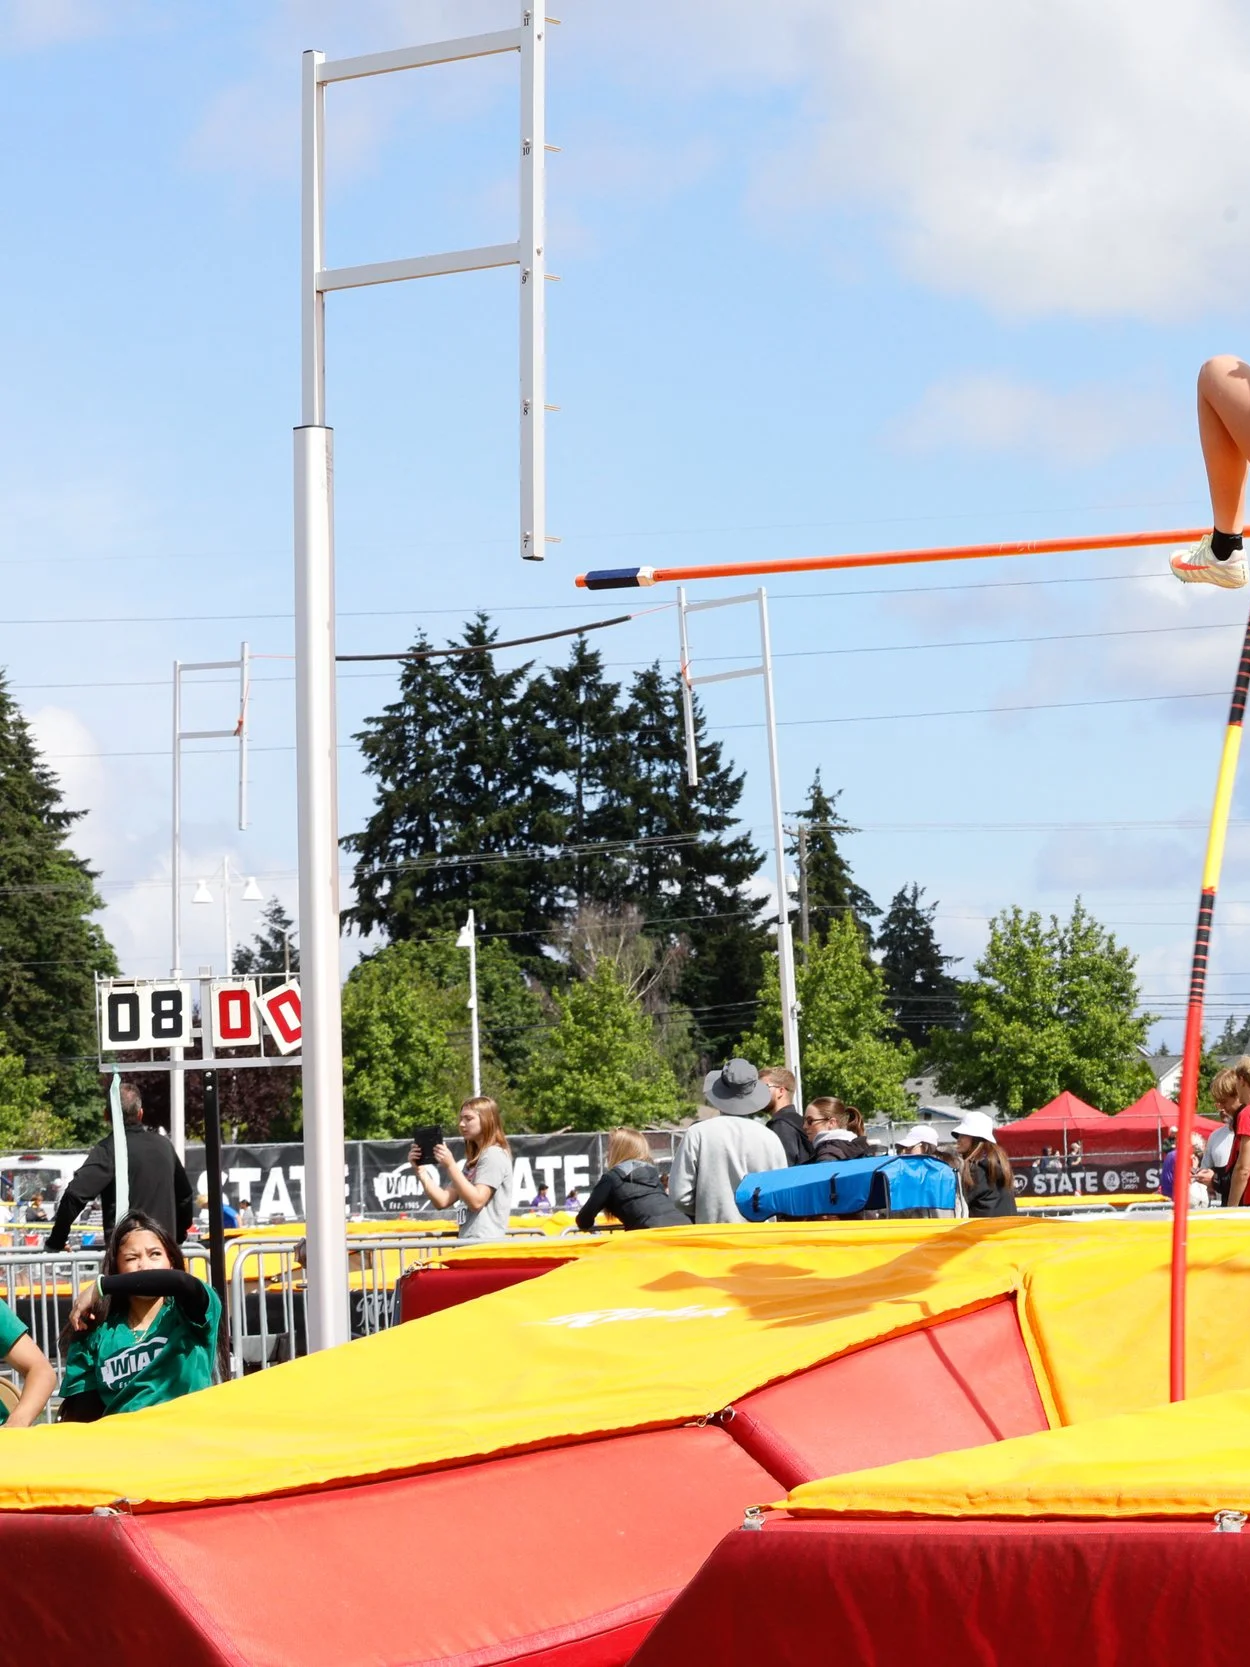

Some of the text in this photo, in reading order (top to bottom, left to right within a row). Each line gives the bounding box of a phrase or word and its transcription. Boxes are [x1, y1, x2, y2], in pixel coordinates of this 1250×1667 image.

[522, 146, 530, 156] 10
[108, 990, 183, 1042] 08
[1033, 1171, 1098, 1194] STATE
